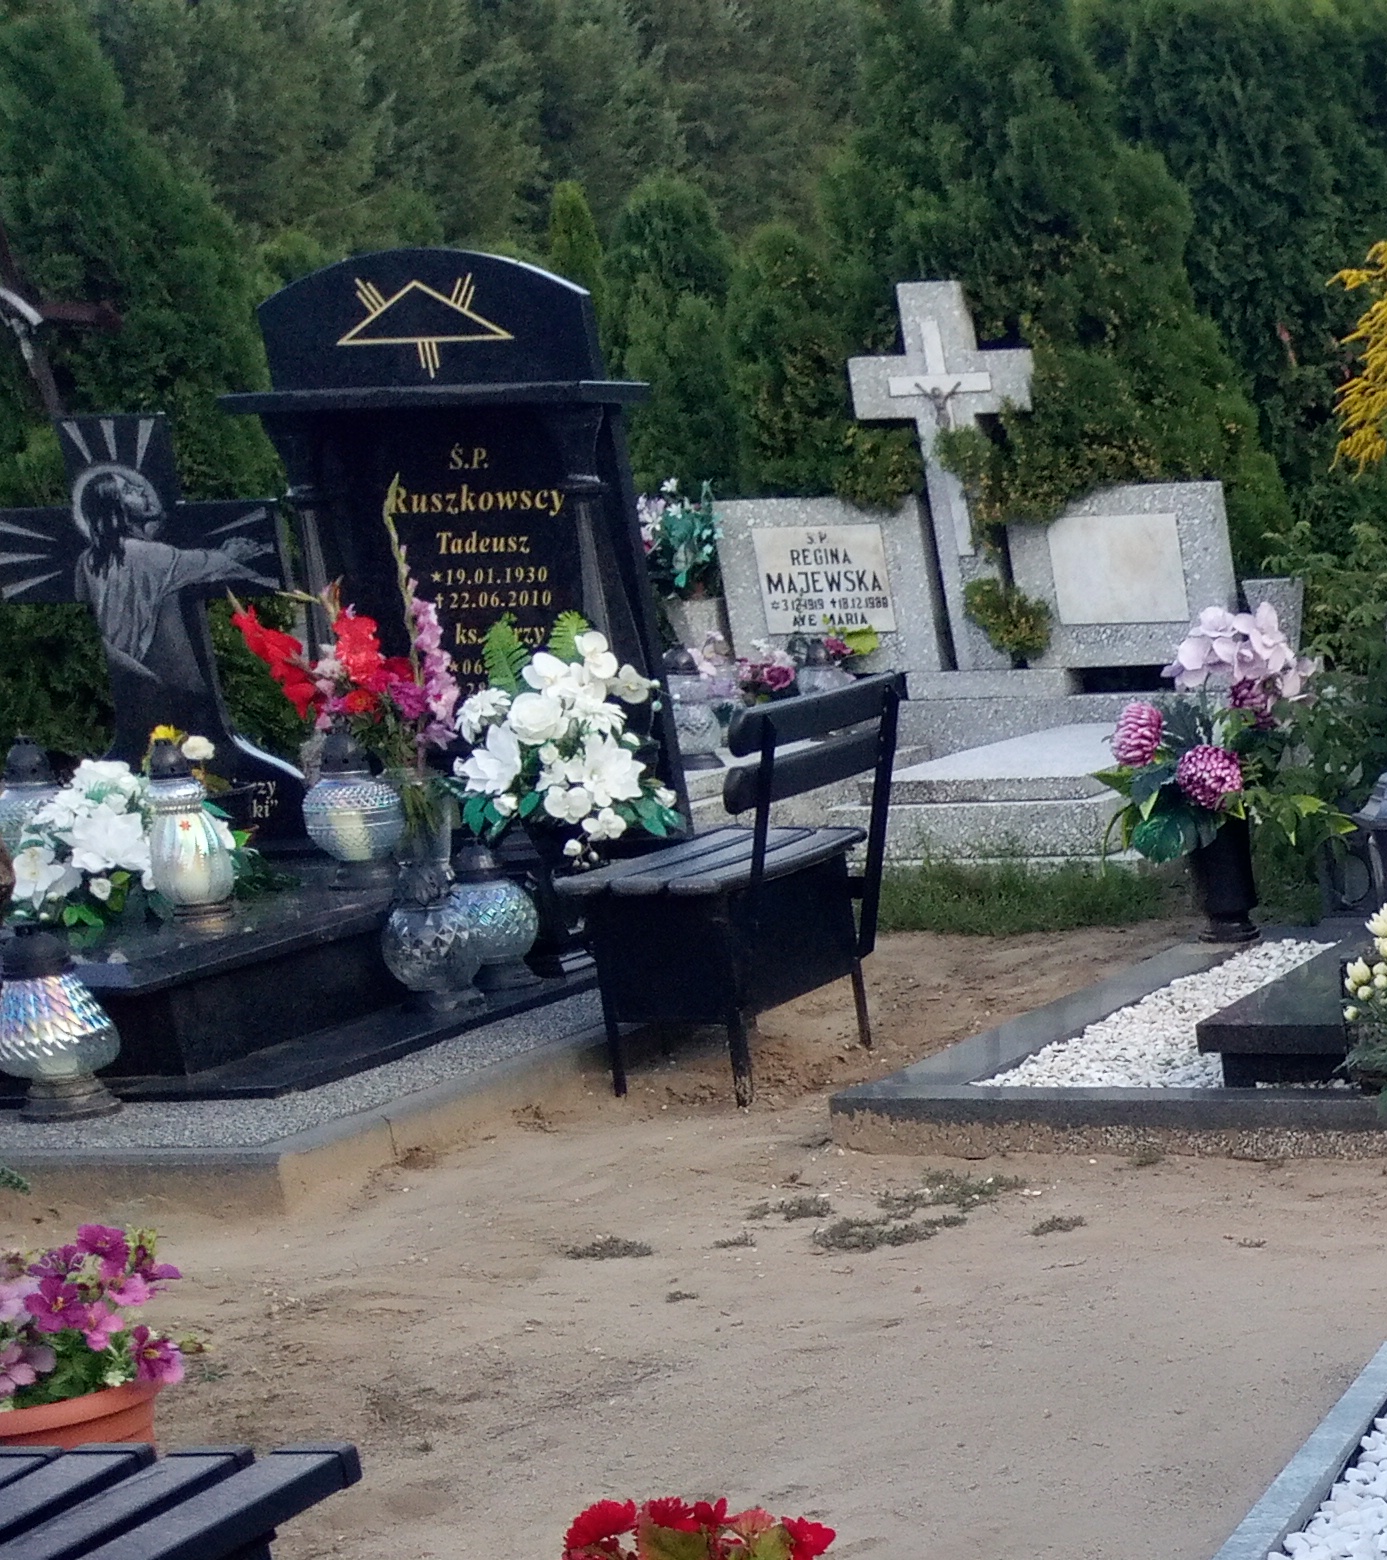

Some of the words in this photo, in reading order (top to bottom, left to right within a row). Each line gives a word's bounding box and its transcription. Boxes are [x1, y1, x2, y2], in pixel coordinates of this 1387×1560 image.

[392, 484, 565, 517] Ruszkowscy
[436, 531, 531, 555] Tadeusz
[790, 548, 852, 566] REGINA
[446, 567, 548, 586] 19.01.1930
[766, 569, 883, 595] MAJEWSKA
[449, 590, 552, 609] 22.06.2010
